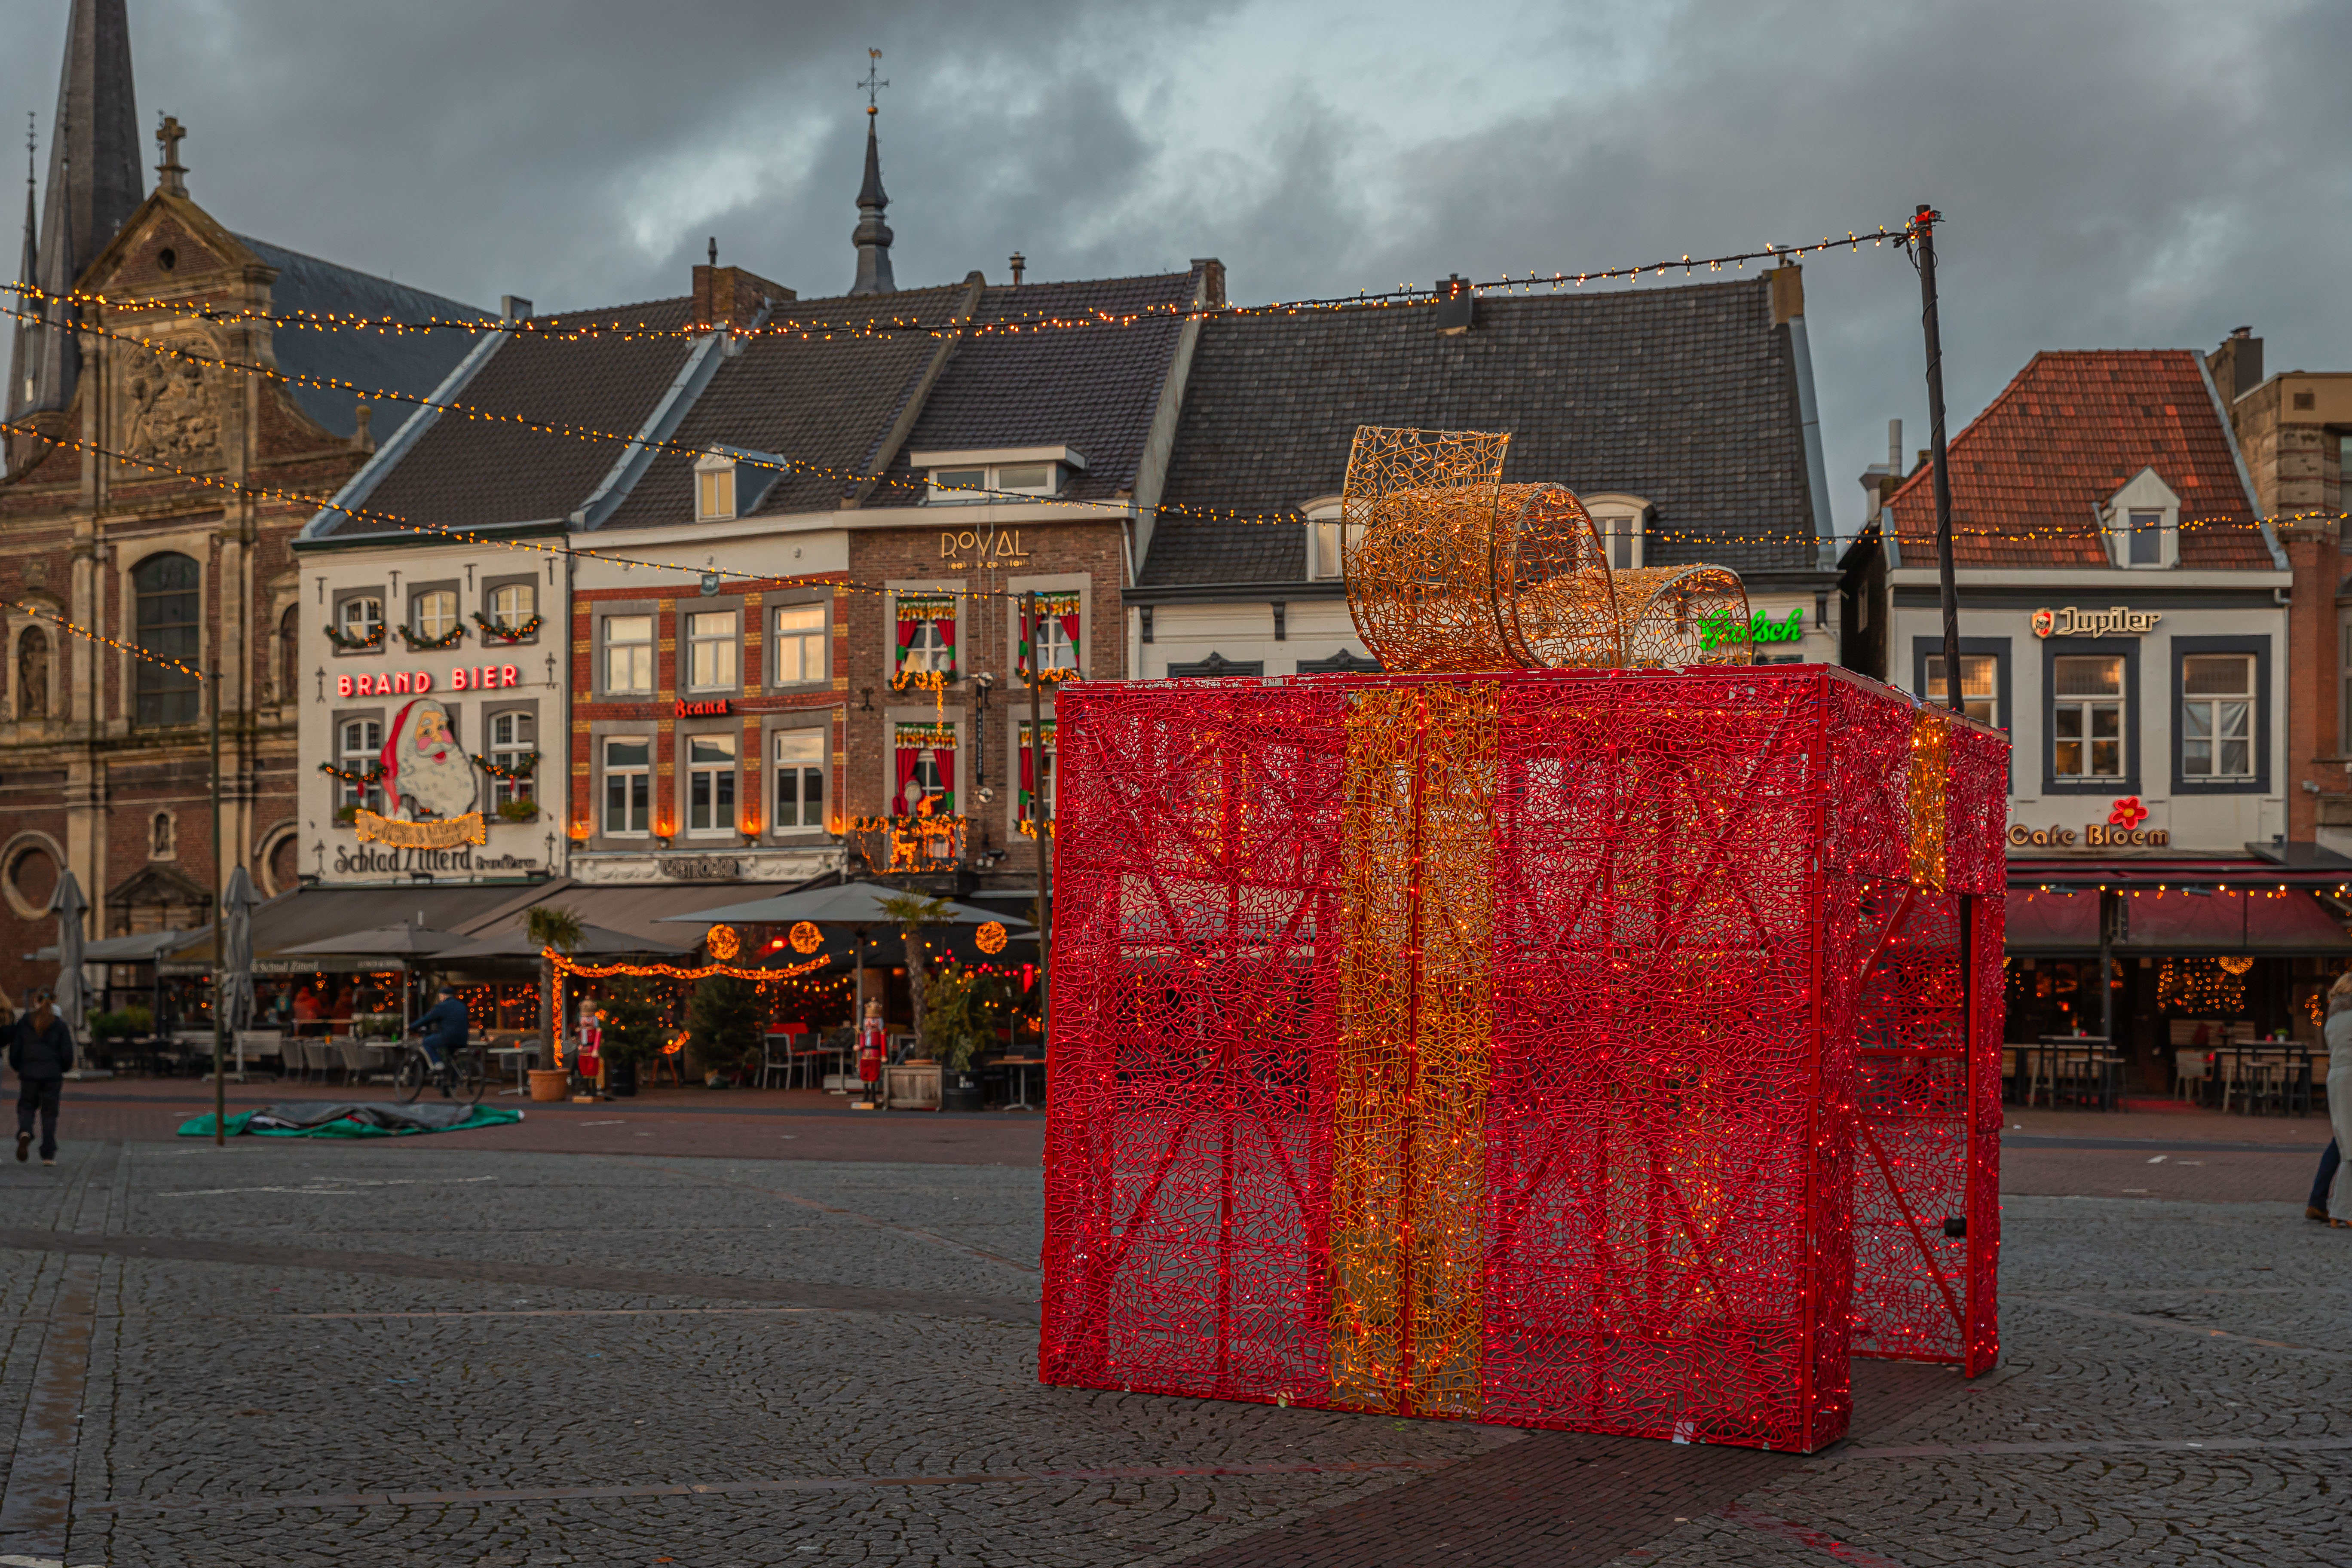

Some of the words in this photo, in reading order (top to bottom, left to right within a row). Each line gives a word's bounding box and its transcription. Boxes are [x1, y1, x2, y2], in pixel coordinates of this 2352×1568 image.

[941, 530, 1029, 559] ROYAL
[2055, 606, 2162, 639] Jupiler
[337, 670, 430, 697] BRAND
[451, 664, 517, 690] BIER
[675, 698, 727, 719] Brand
[2009, 824, 2076, 846] Cafe
[2086, 824, 2170, 846] Bloem
